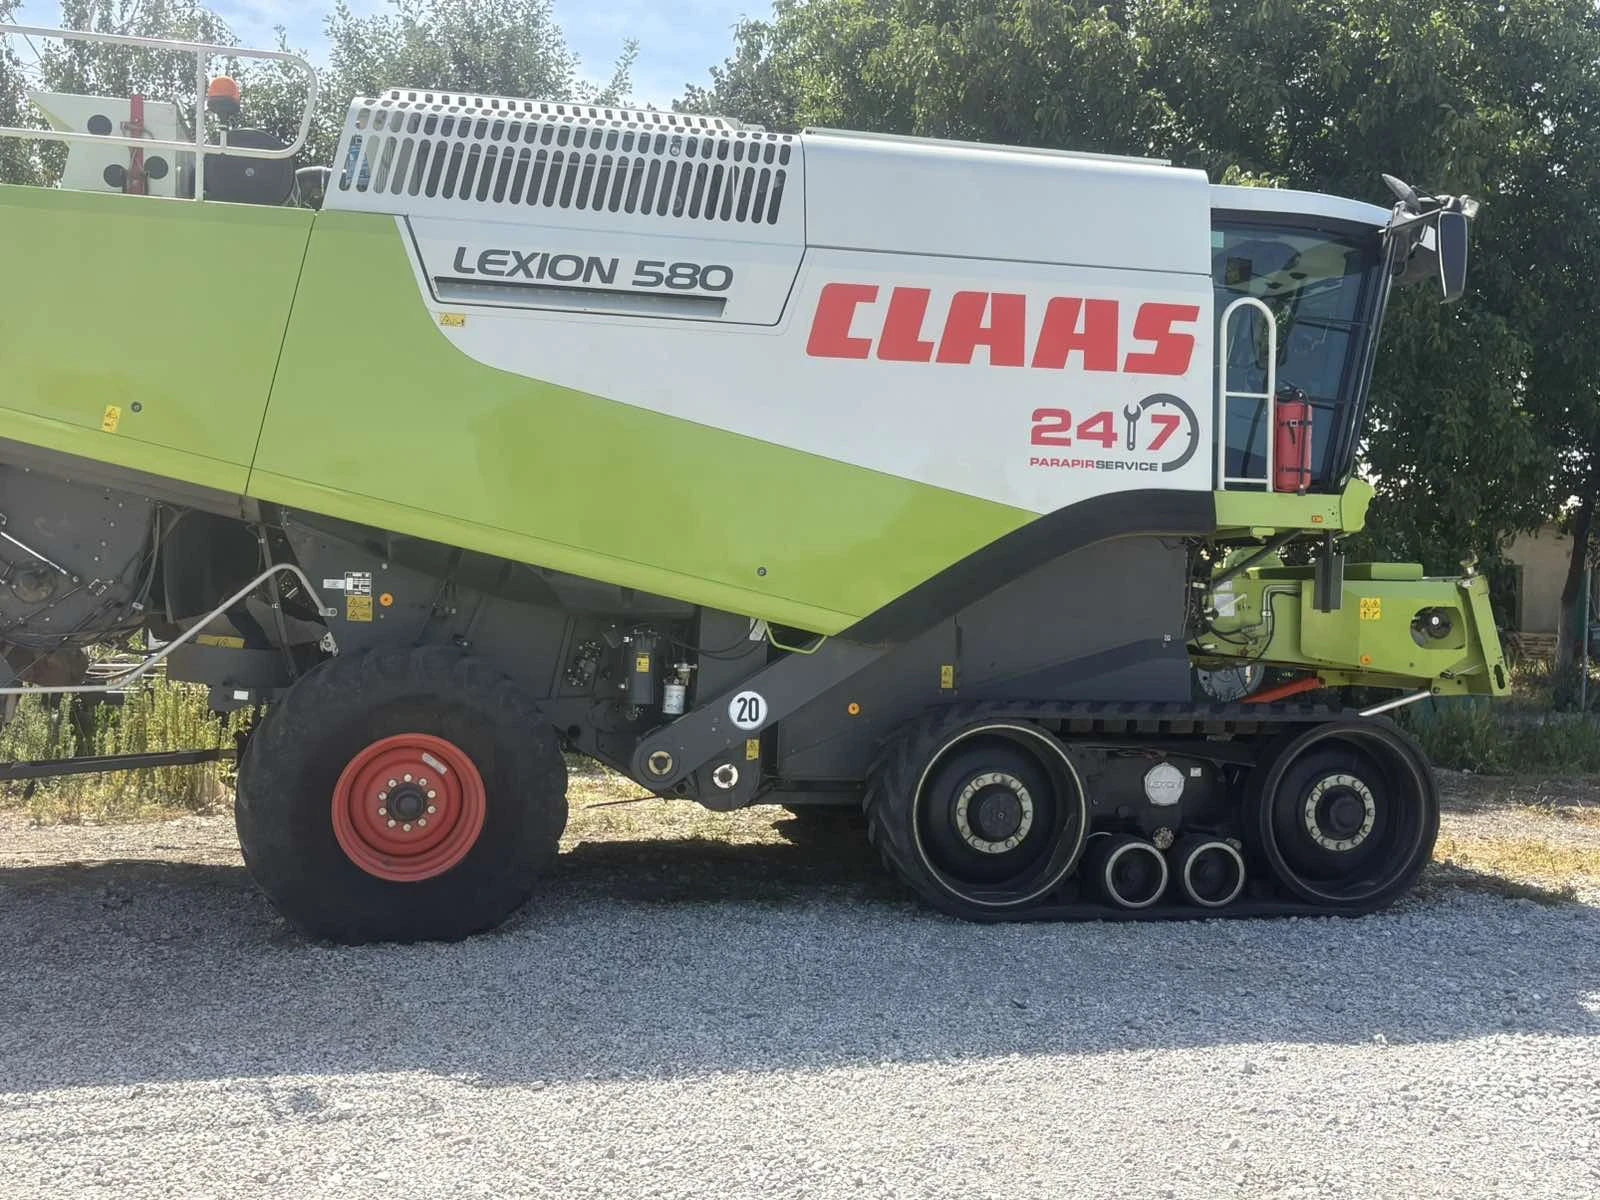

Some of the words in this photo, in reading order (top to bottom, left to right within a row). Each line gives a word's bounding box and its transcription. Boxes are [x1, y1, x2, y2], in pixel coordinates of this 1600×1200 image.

[454, 246, 620, 284] LEXION
[632, 260, 734, 291] 580
[806, 283, 1199, 376] CLAAS
[1031, 408, 1118, 448] 24
[1030, 457, 1158, 472] PARAPIRSERVICE
[737, 697, 759, 723] 20
